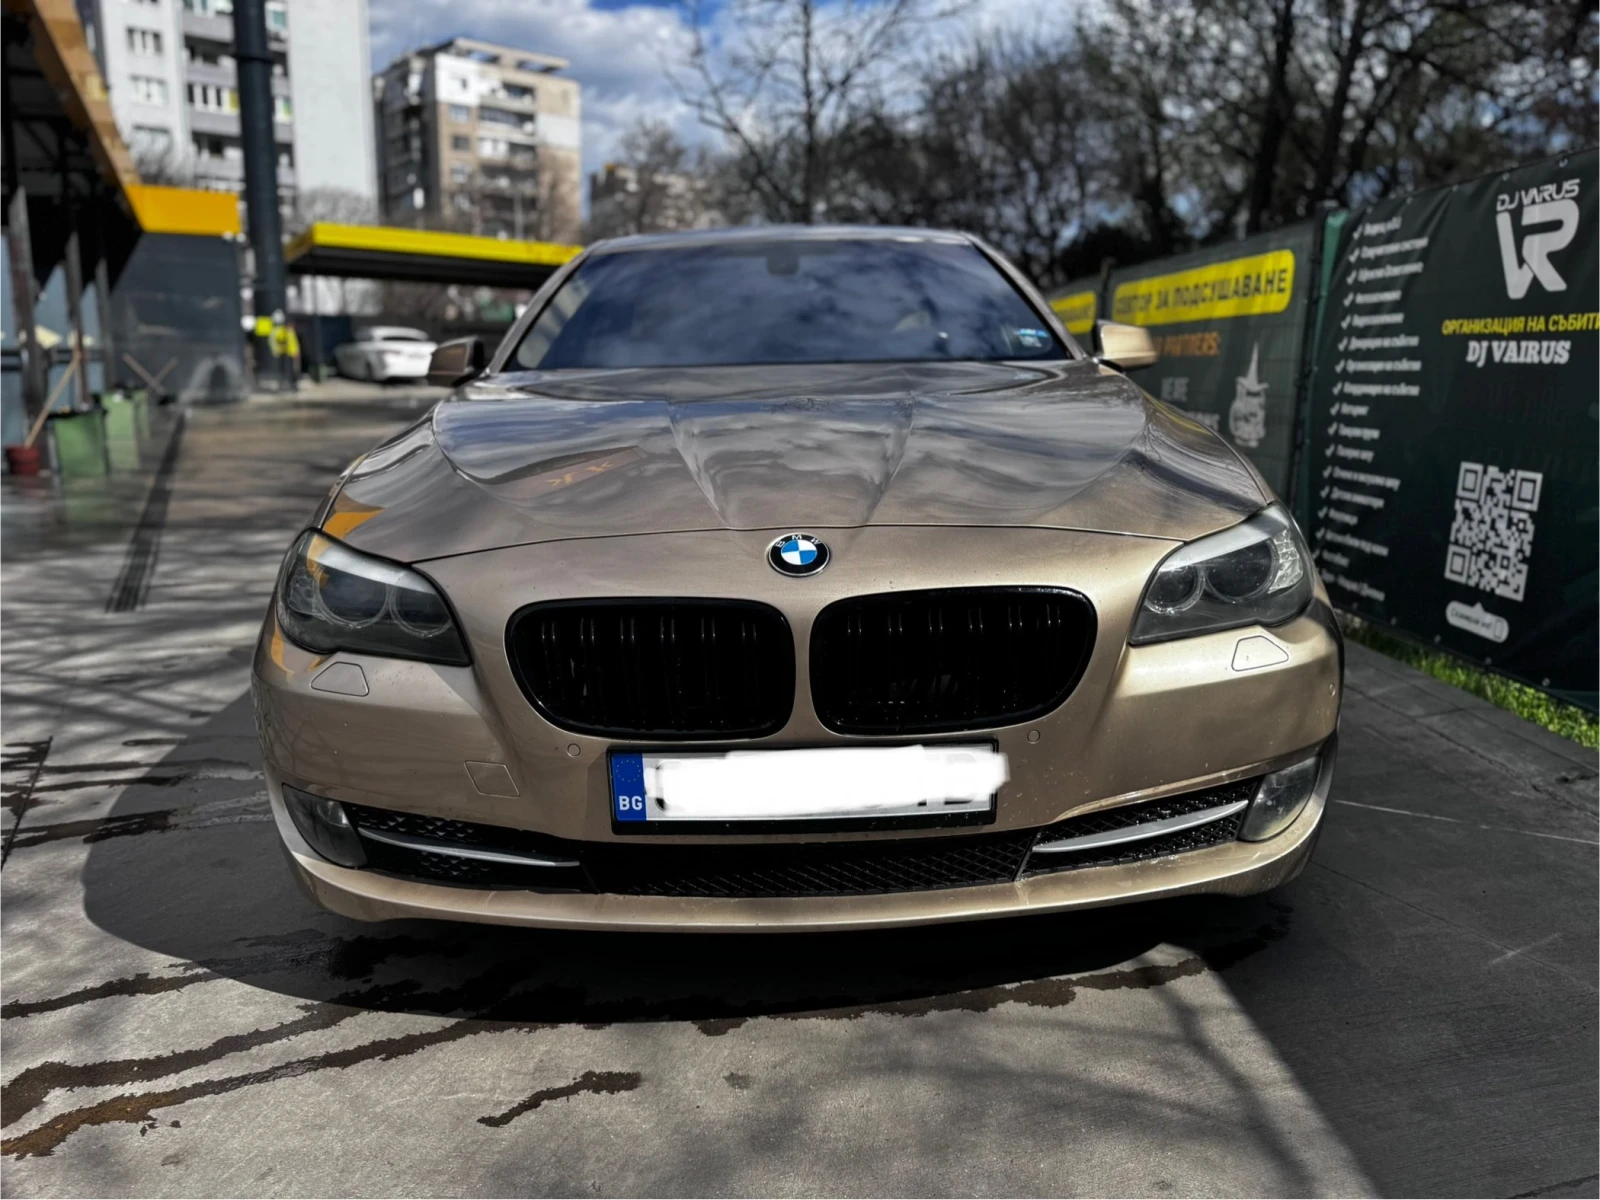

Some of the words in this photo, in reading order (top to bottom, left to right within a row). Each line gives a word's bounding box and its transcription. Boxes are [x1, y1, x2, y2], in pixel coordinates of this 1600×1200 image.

[1496, 191, 1519, 212] DJ
[1441, 316, 1526, 336] ОРГАНИЗАЦИЯ
[1526, 315, 1546, 332] НА
[1466, 340, 1490, 368] DJ
[1491, 340, 1571, 365] VAIRUS
[775, 534, 822, 547] BMW
[618, 795, 643, 811] BG
